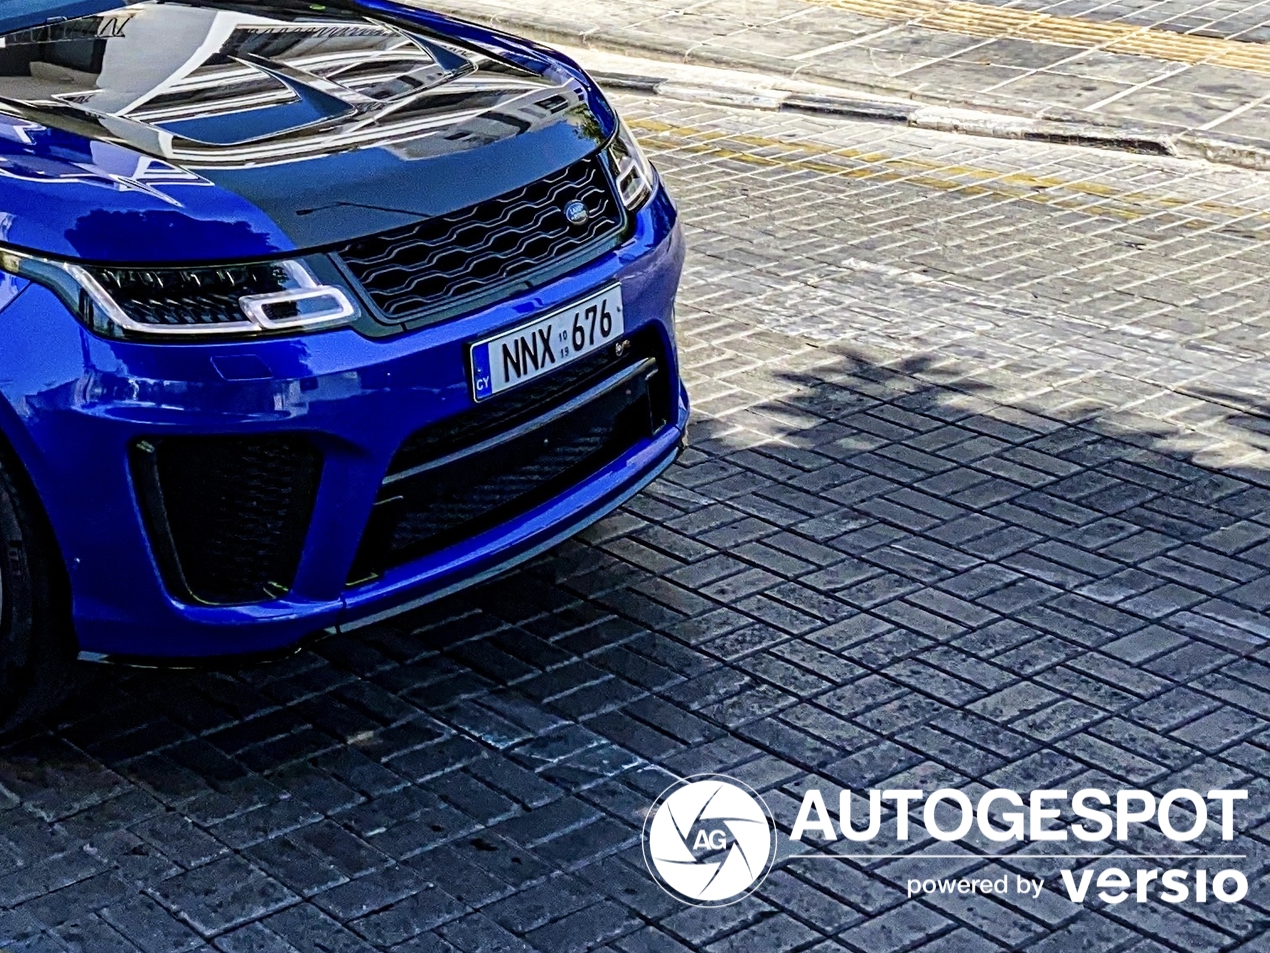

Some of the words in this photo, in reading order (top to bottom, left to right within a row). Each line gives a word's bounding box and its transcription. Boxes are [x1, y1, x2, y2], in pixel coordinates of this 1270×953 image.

[502, 324, 556, 383] NNX
[572, 298, 612, 352] 676
[558, 329, 568, 342] 10
[476, 376, 490, 391] CY
